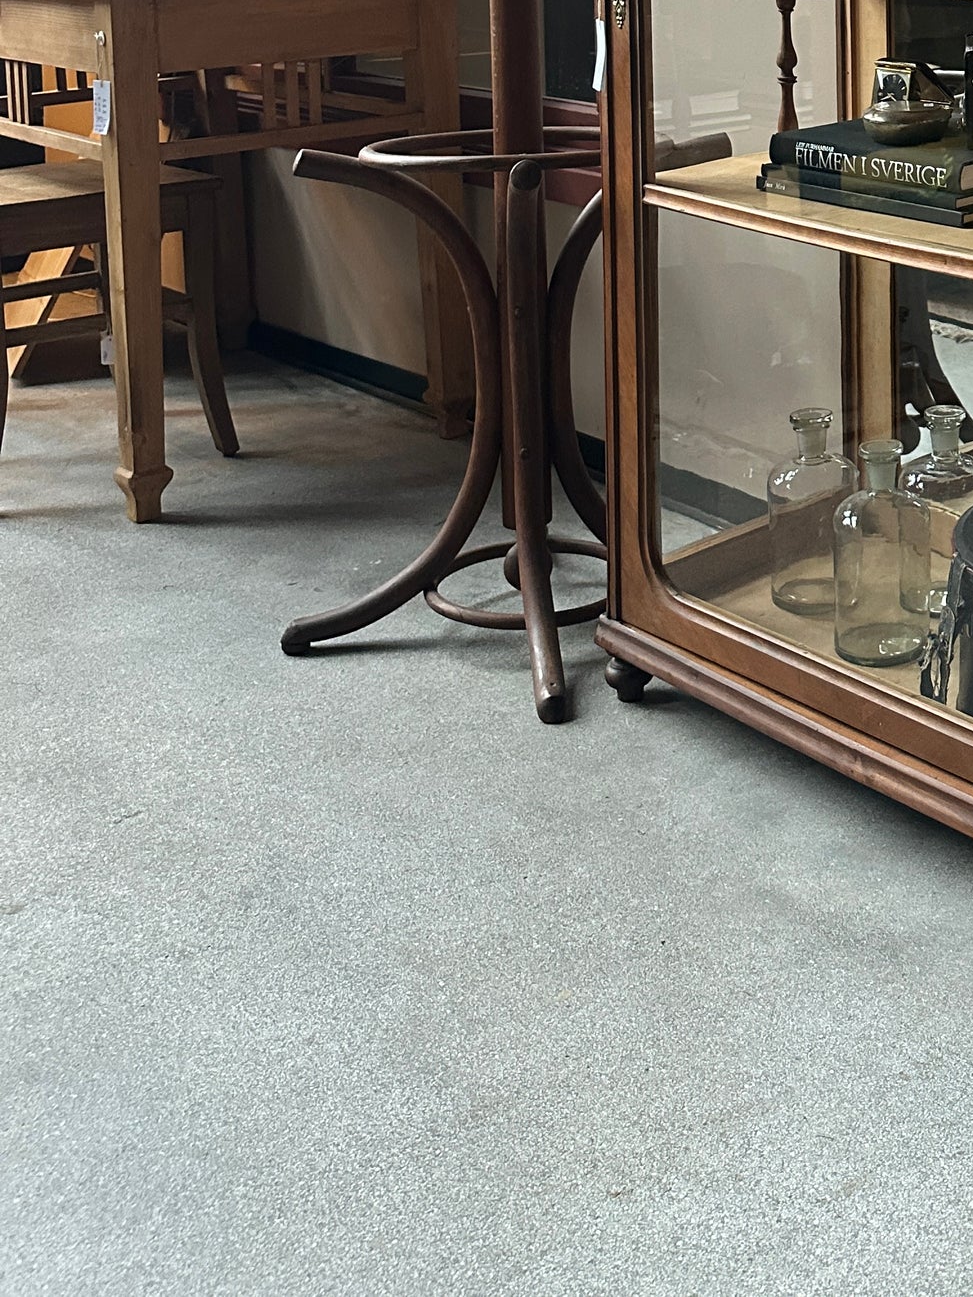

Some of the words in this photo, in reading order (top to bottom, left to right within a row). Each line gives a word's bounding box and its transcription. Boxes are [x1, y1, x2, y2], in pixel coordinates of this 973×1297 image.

[795, 147, 857, 174] FILMEN
[861, 156, 868, 176] I
[871, 158, 947, 188] SVERIGE
